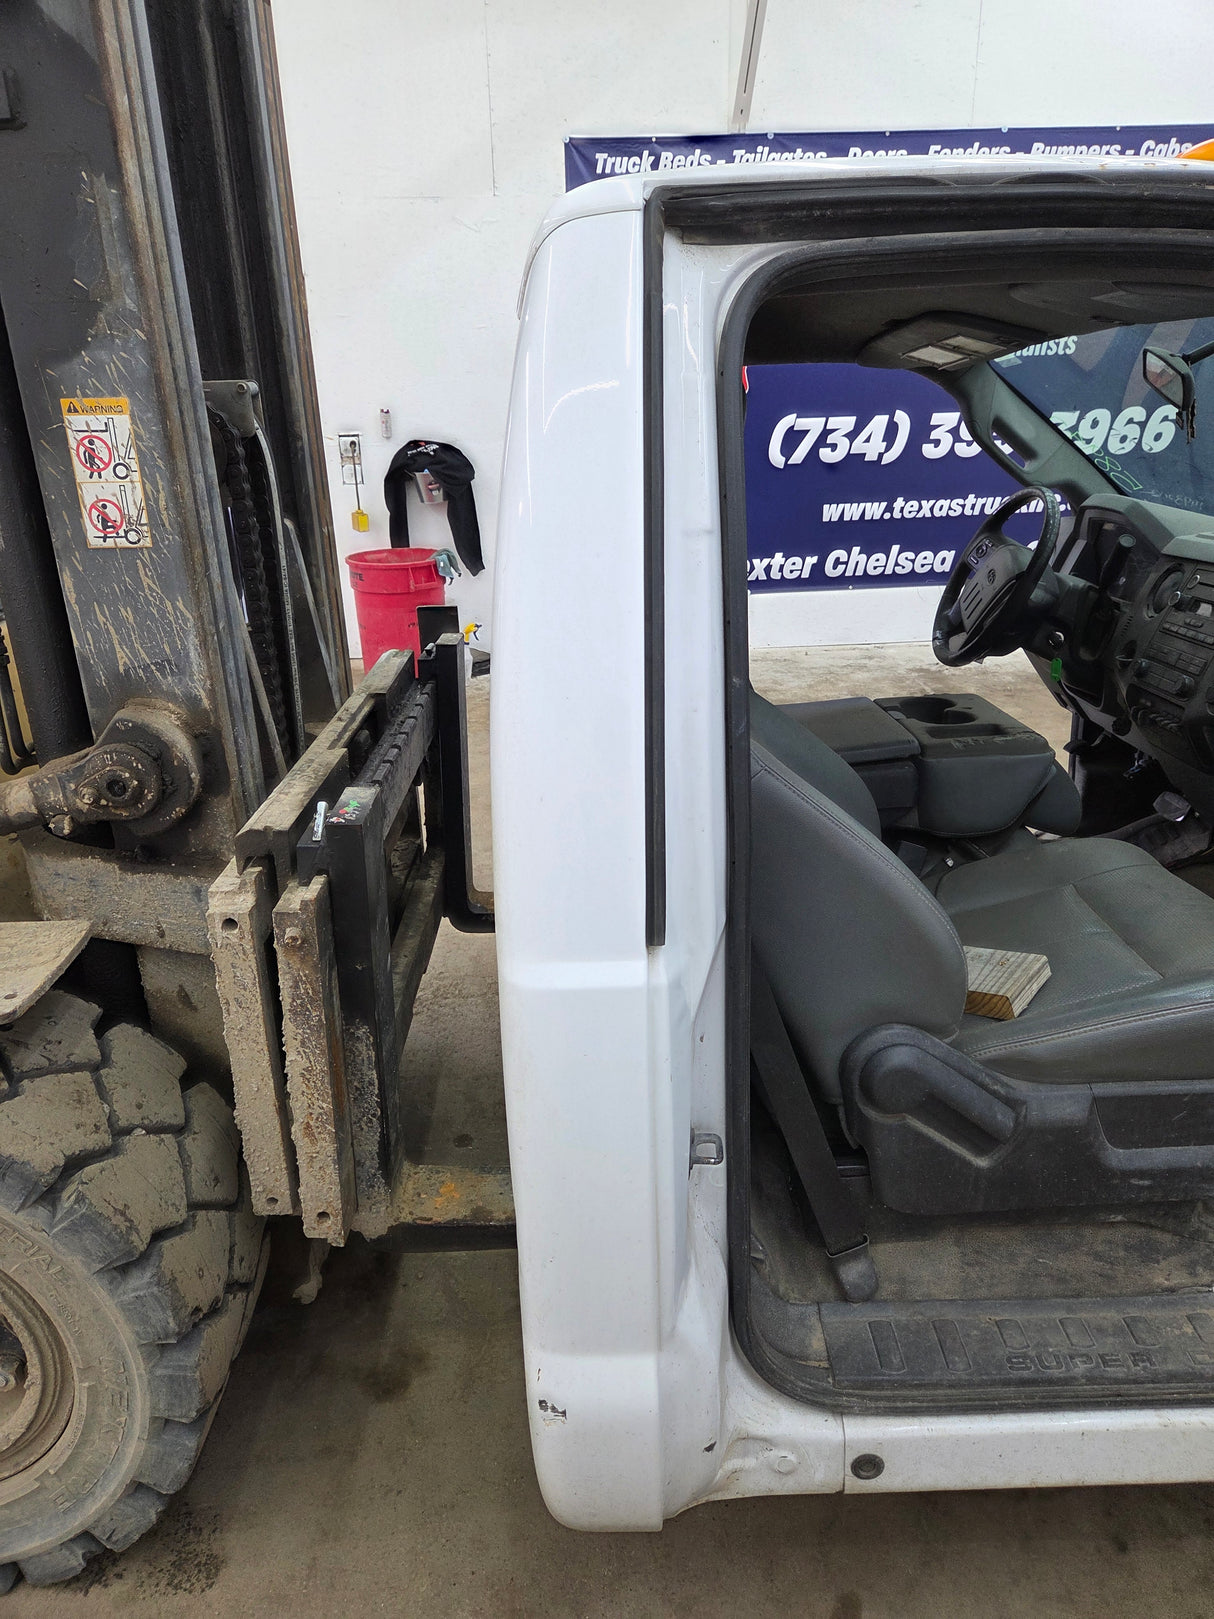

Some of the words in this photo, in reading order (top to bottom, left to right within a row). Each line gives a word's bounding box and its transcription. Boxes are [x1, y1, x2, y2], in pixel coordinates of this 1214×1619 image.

[595, 149, 655, 174] Truck
[657, 148, 711, 171] Beds
[1140, 138, 1193, 158] Cabs
[80, 404, 124, 414] WARNING
[768, 409, 911, 469] (734)
[747, 552, 818, 581] xter
[824, 544, 956, 578] Chelsea
[1004, 1351, 1159, 1373] SUPER
